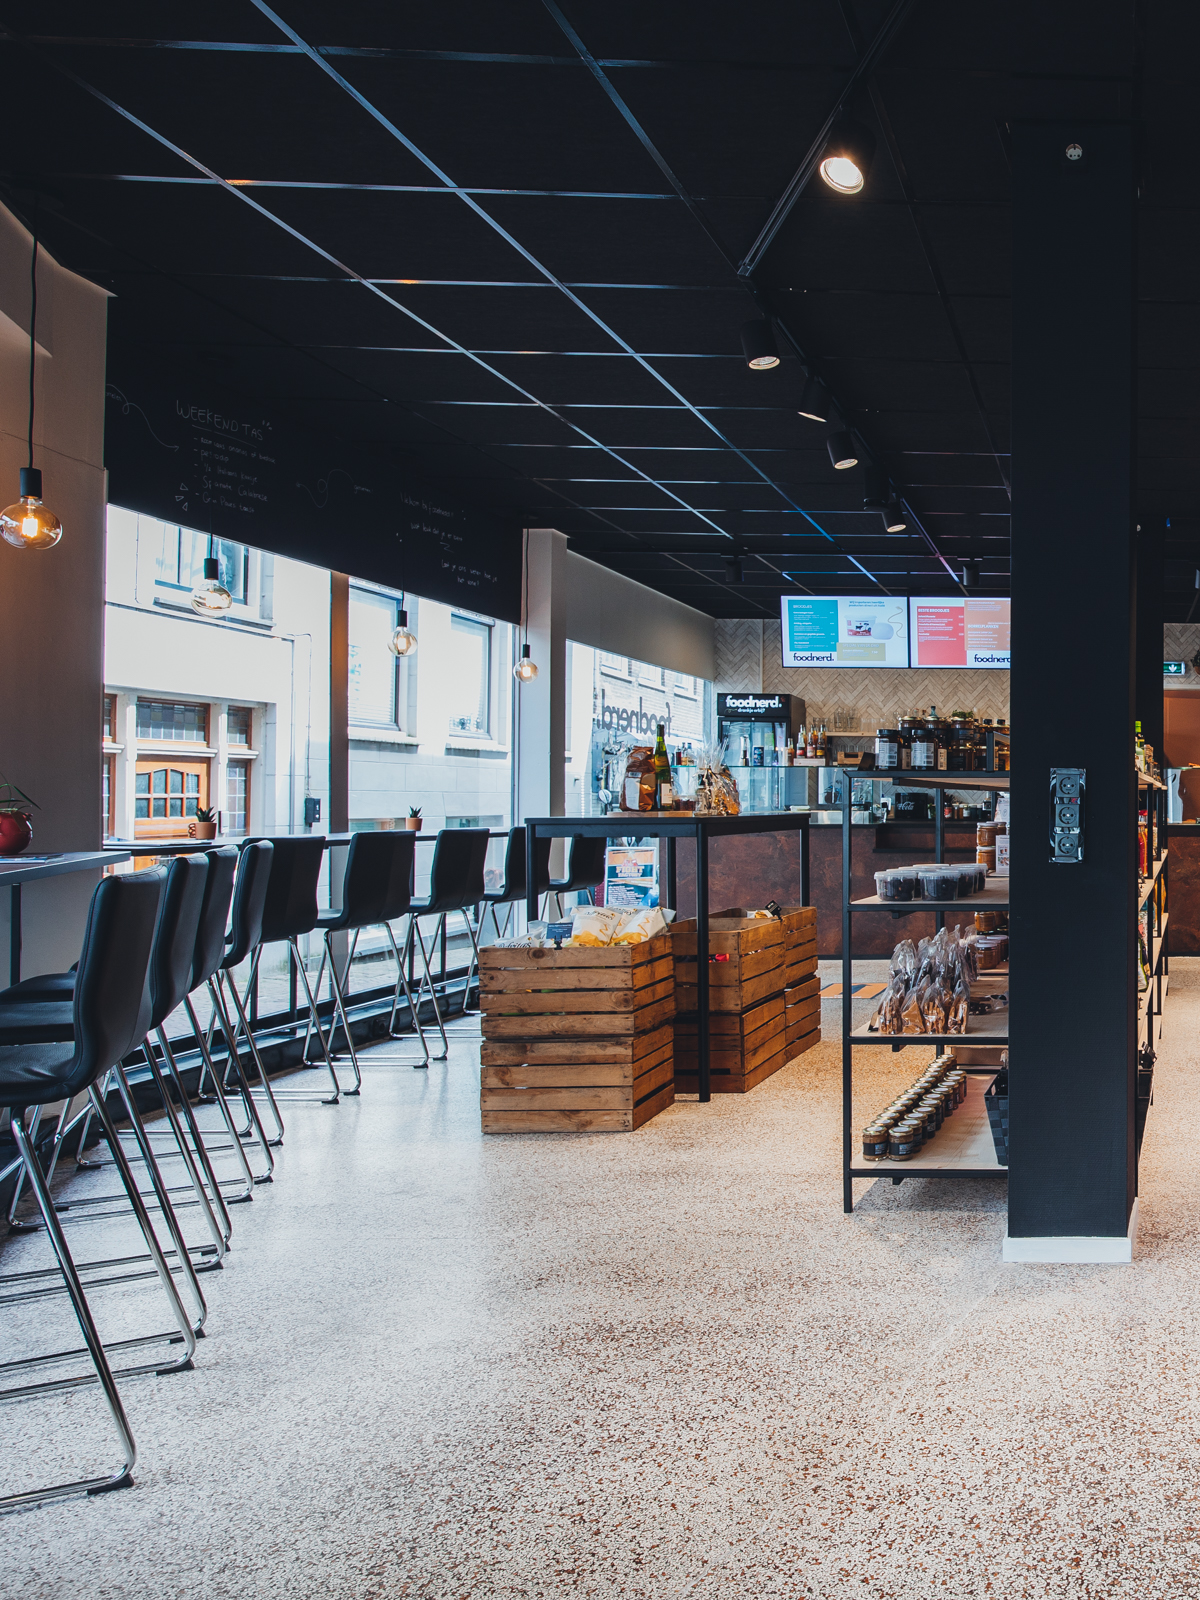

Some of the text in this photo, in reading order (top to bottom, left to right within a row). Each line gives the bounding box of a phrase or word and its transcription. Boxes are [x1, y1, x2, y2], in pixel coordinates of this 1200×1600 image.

[176, 399, 264, 441] WEEKEND TAS
[793, 652, 835, 662] foodnerd.
[726, 695, 782, 708] foodnerd.
[616, 865, 645, 874] FIGHT
